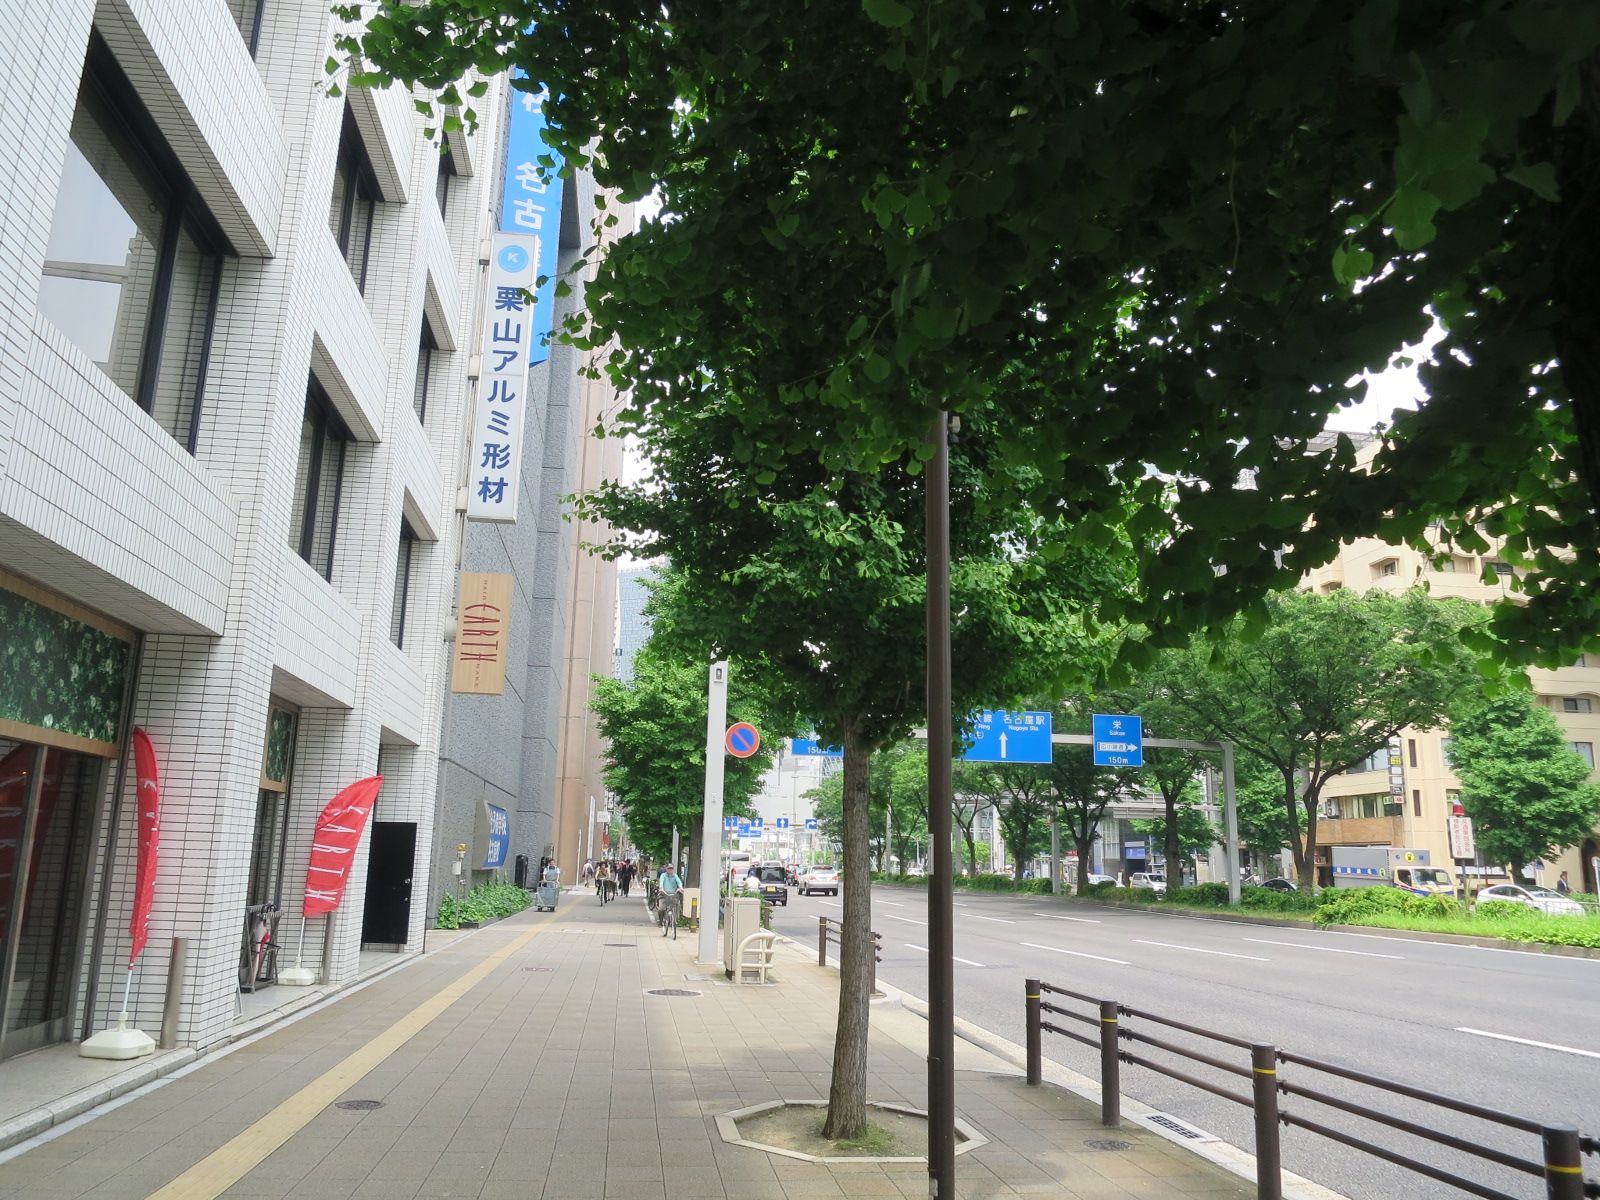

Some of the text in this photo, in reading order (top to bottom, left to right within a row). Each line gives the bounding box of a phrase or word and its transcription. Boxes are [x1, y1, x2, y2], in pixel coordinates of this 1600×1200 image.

[477, 286, 524, 504] 栗山アルミ形材
[460, 604, 501, 662] EARTH
[1002, 715, 1045, 726] 名古屋駅
[1112, 719, 1122, 730] 栄
[1108, 756, 1129, 764] 150m
[304, 805, 369, 904] EARTH
